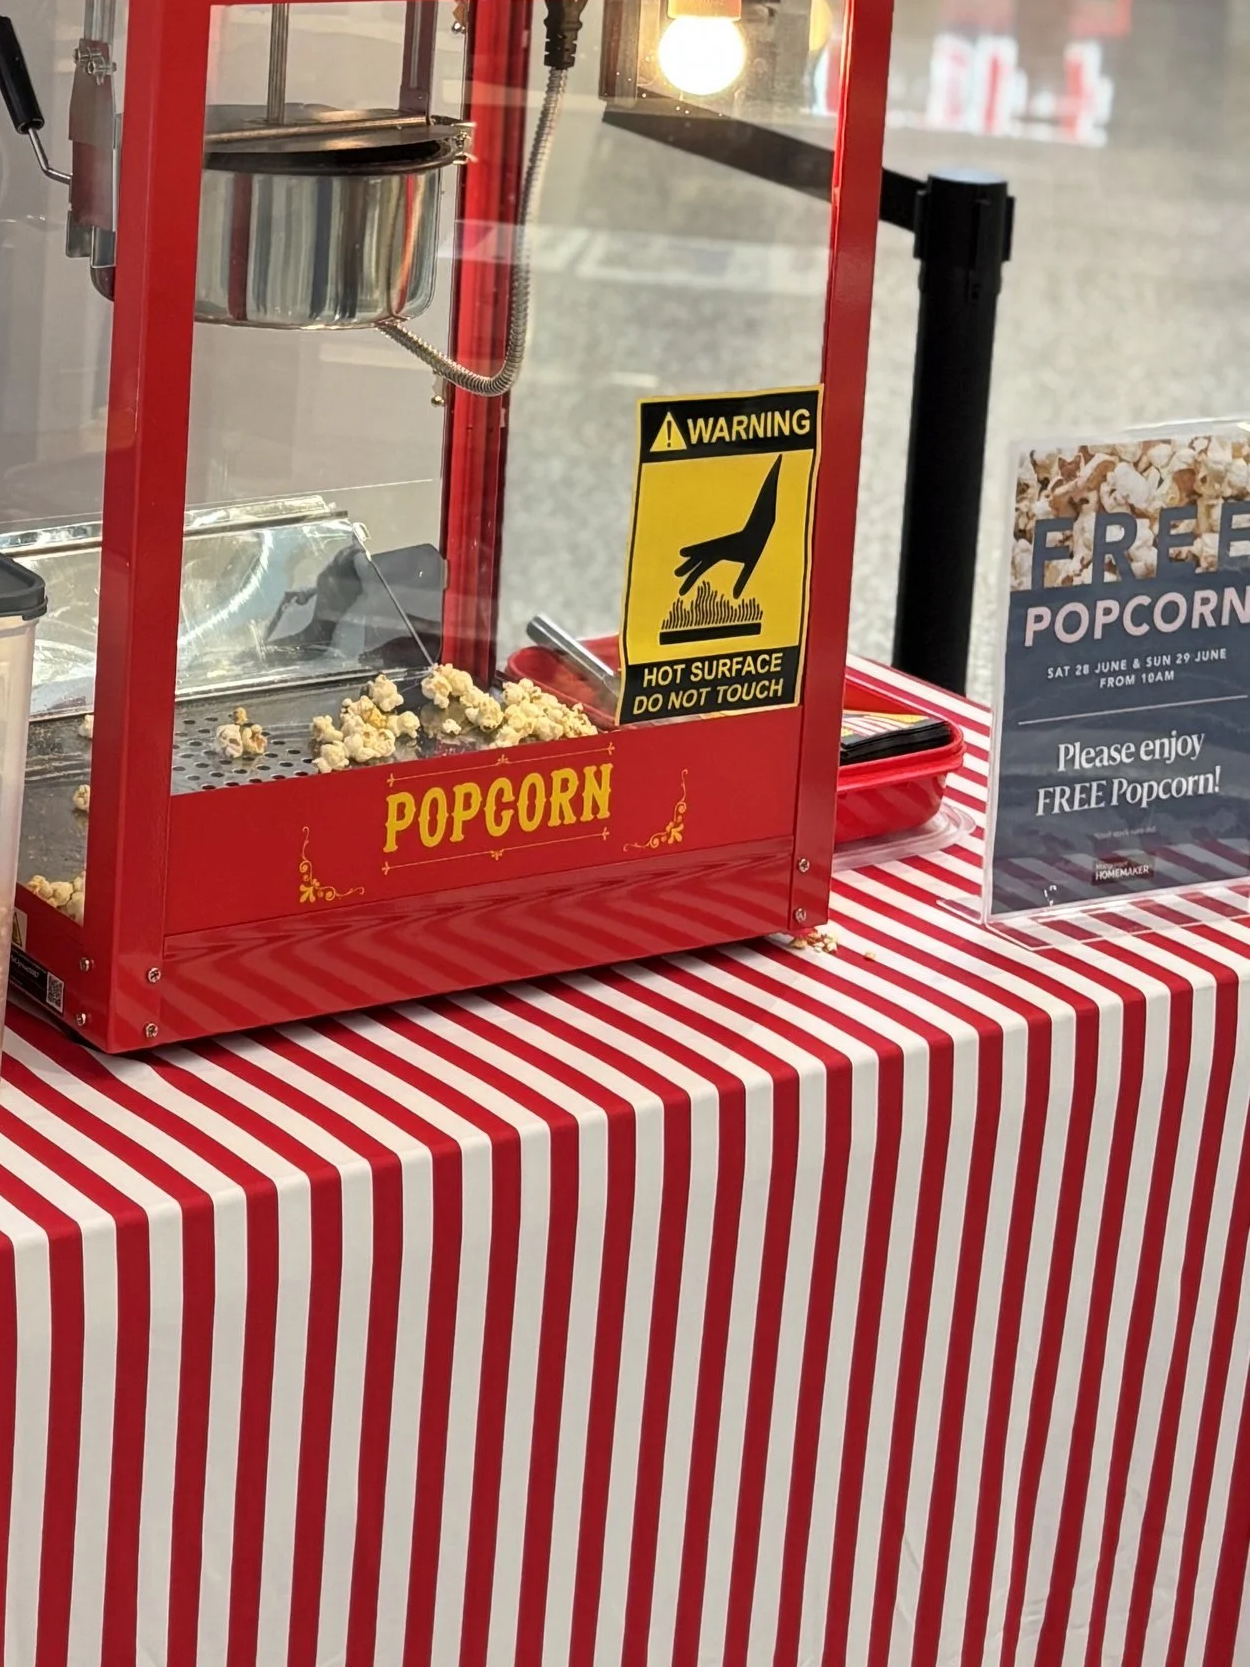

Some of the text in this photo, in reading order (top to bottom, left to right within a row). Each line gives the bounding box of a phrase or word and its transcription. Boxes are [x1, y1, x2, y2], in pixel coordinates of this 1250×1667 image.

[687, 408, 811, 445] WARNING
[1031, 499, 1250, 591] FREE
[1024, 584, 1250, 647] POPCORN
[643, 652, 783, 688] HOT SURFACE
[1047, 648, 1227, 679] SAT 28 JUNE & SUN 29 JUNE
[1099, 670, 1175, 688] FROM 10AM
[632, 677, 783, 715] DO NOT TOUCH
[1057, 730, 1205, 772] Please enjoy
[382, 762, 614, 854] POPCORN
[1035, 765, 1221, 816] FREE Popcorn!
[1095, 865, 1149, 881] HOMEMAKER
